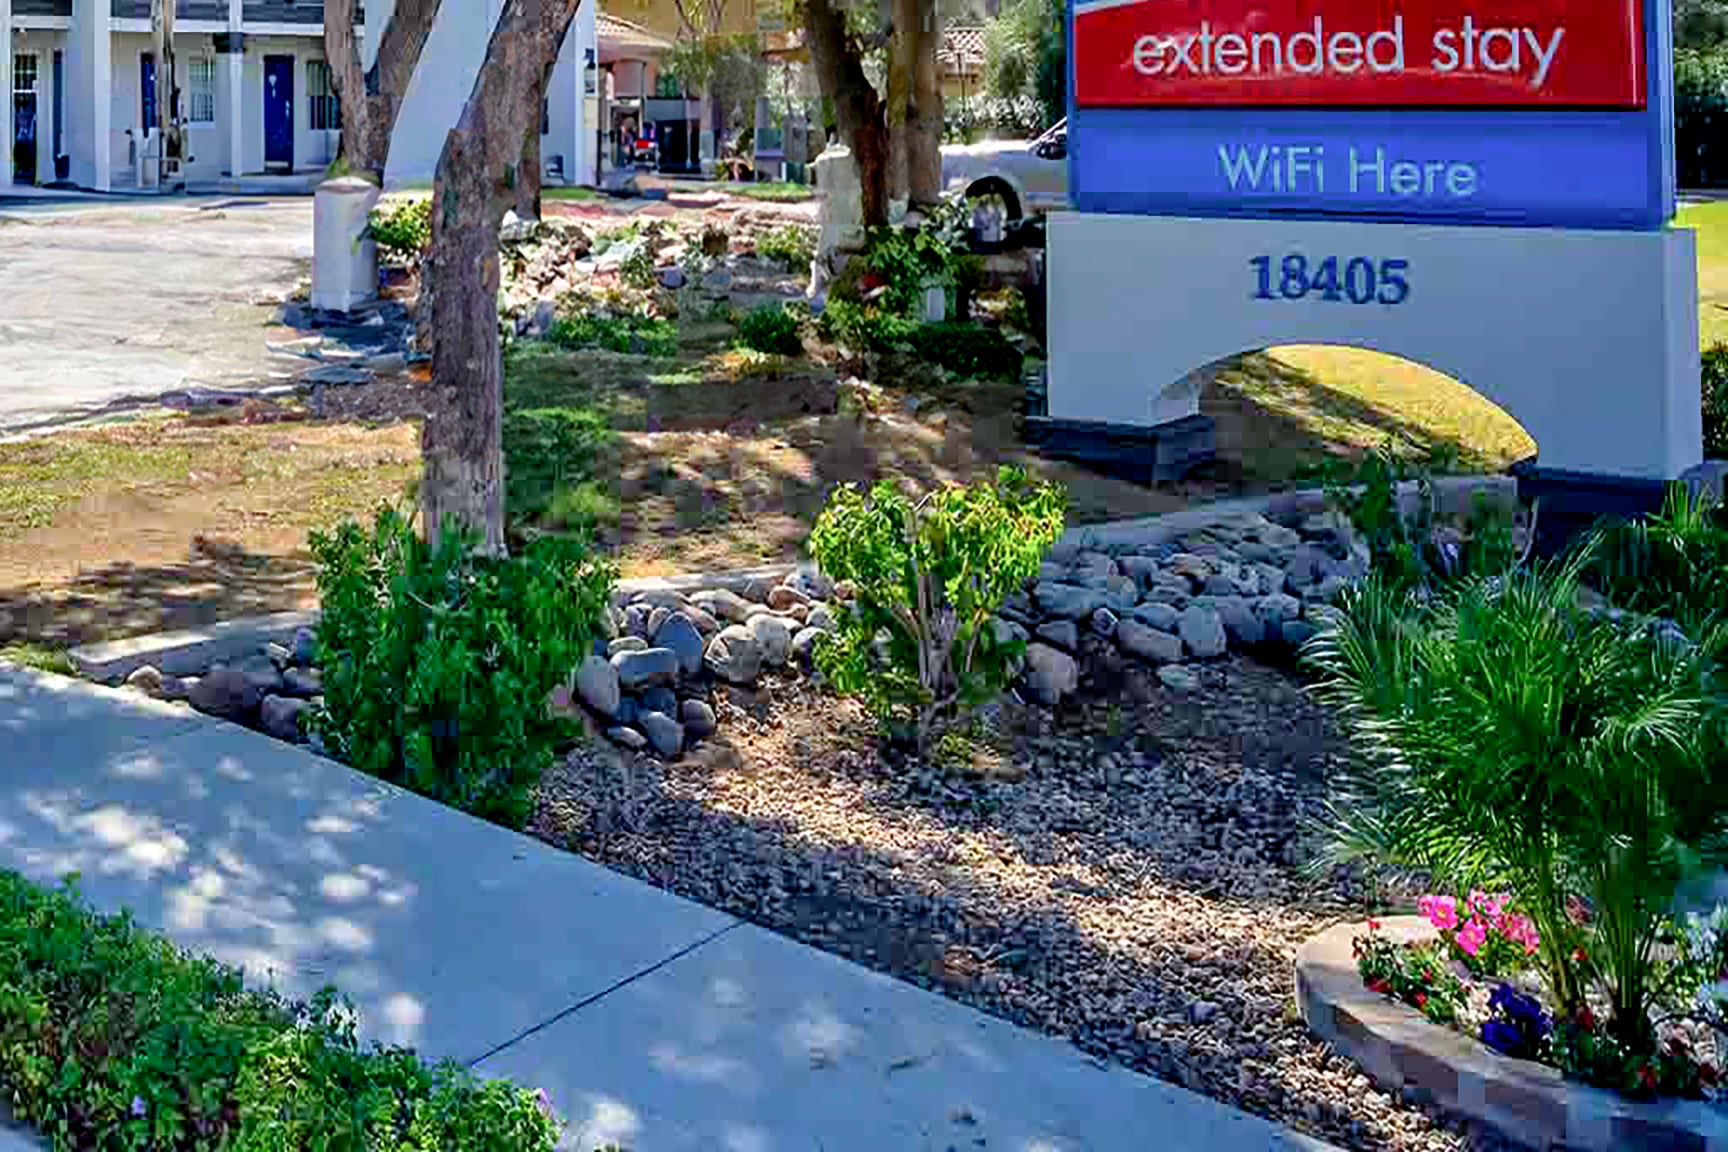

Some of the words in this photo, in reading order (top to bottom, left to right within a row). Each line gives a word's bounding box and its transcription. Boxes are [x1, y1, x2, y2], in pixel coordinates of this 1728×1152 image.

[1132, 16, 1405, 74] extended
[1430, 16, 1566, 90] stay
[1218, 145, 1325, 193] WiFi
[1349, 145, 1479, 197] Here
[1248, 254, 1410, 305] 18405
